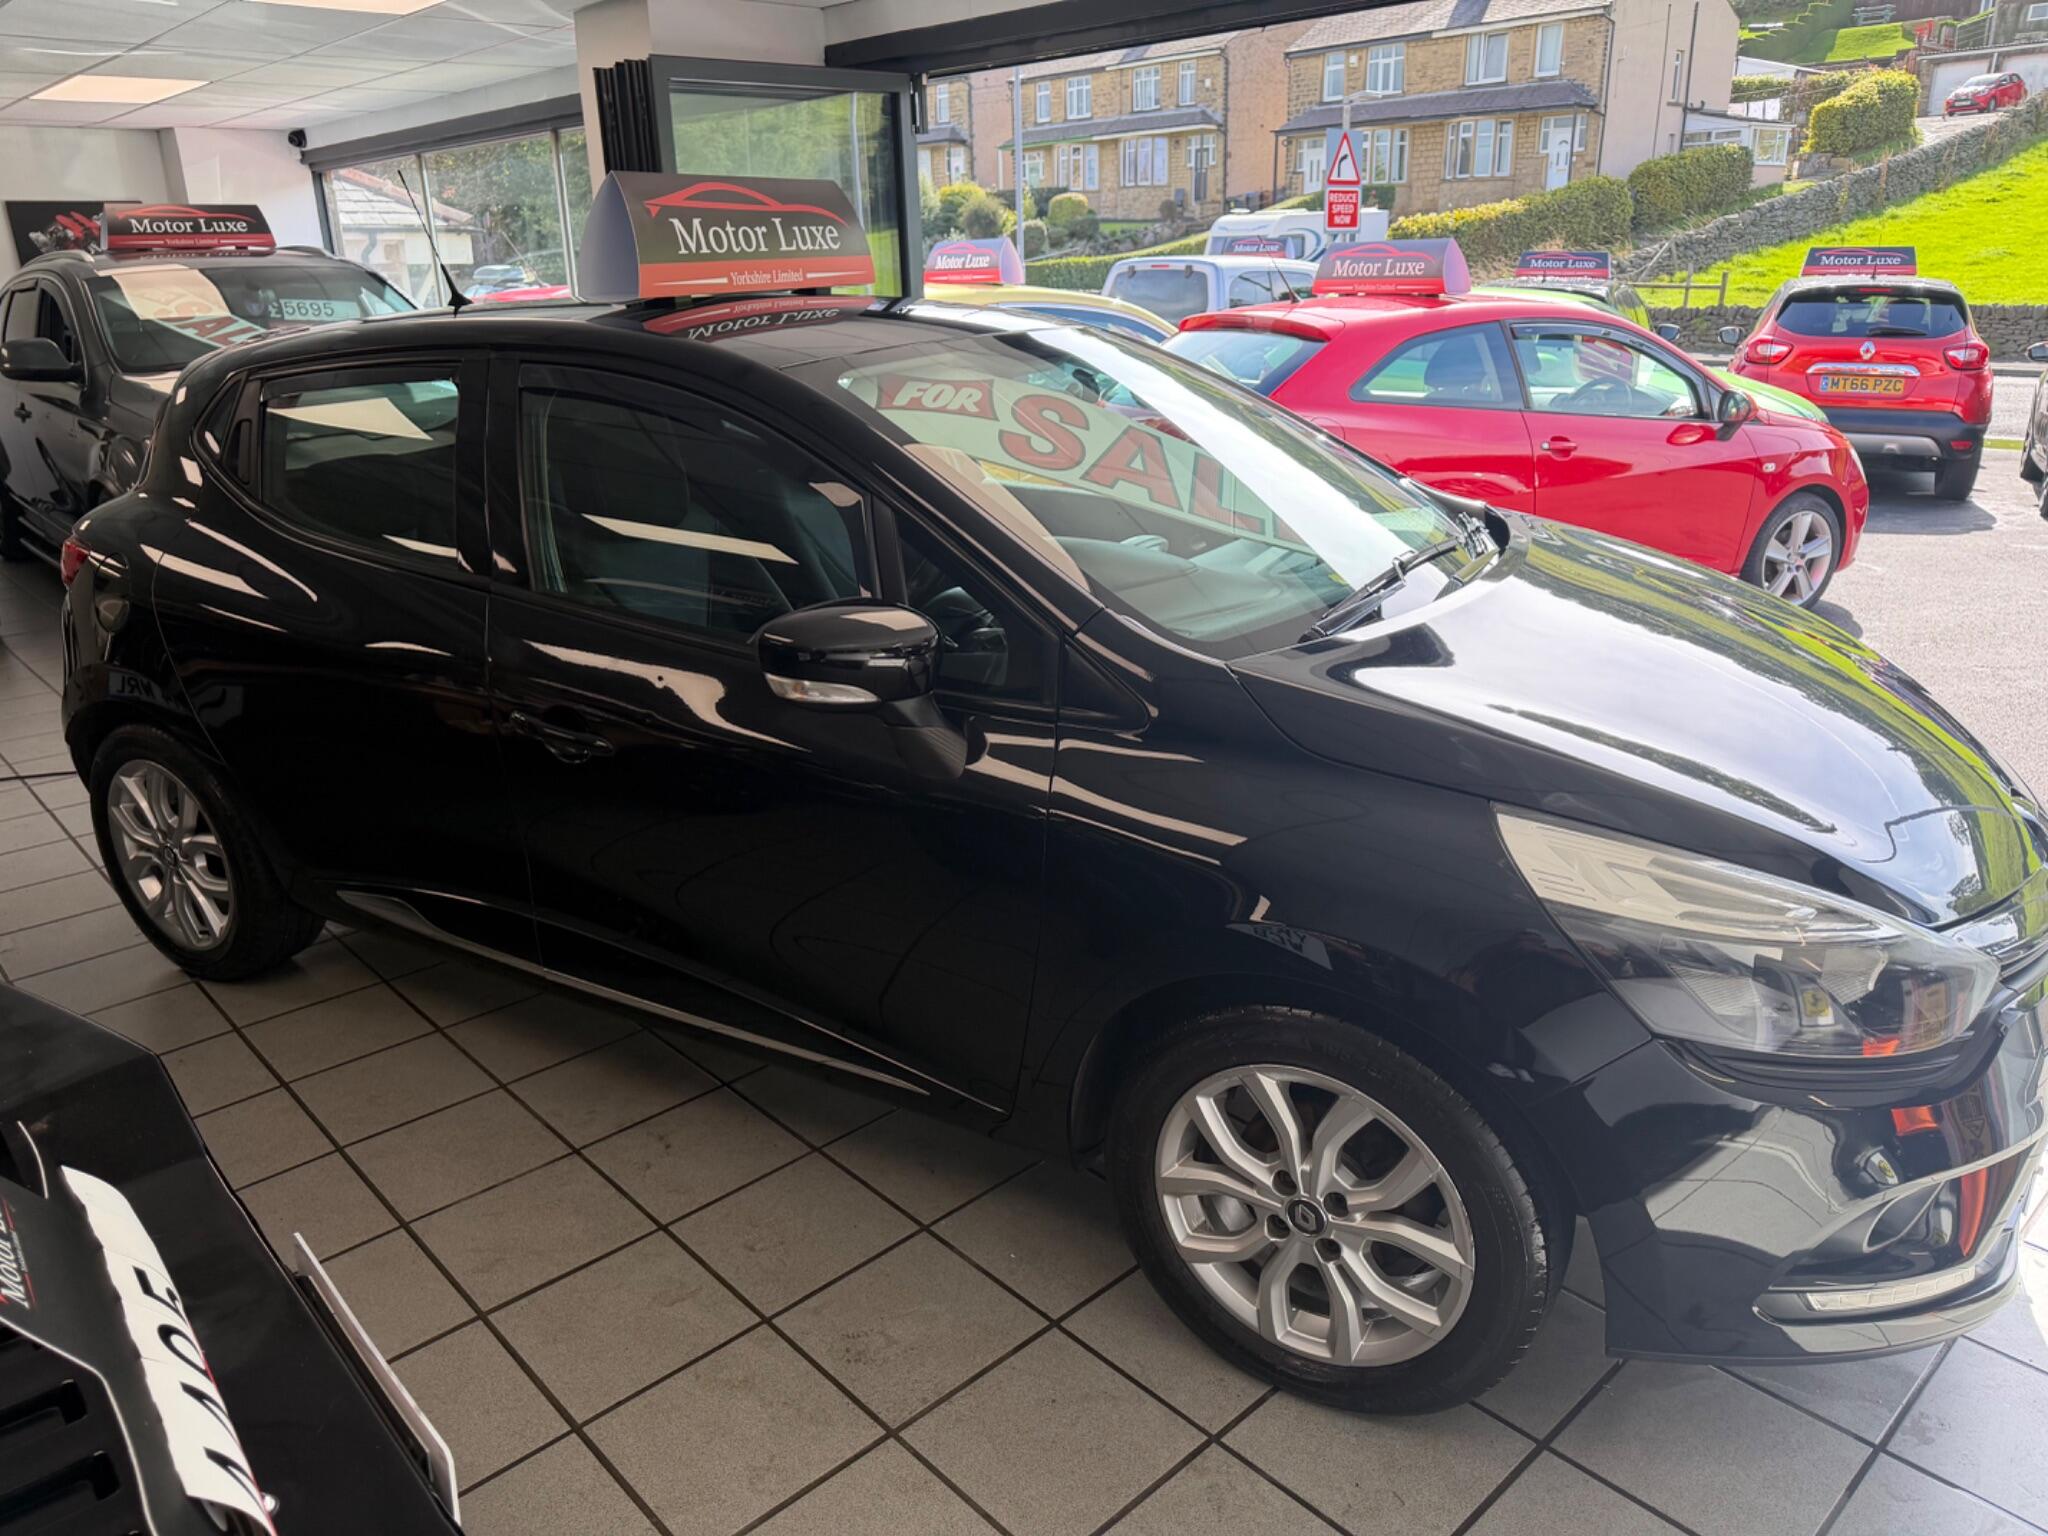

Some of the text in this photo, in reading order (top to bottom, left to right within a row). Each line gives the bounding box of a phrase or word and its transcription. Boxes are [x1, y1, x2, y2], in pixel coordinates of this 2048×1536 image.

[1329, 192, 1356, 203] REDUCE
[1331, 203, 1355, 214] SPEED
[128, 218, 248, 233] Motor Luxe
[1334, 214, 1351, 224] NOW
[669, 217, 841, 255] Motor Luxe
[935, 253, 990, 269] Motor Luxe
[1530, 258, 1597, 269] Motor Luxe
[1820, 255, 1902, 265] Motor Luxe
[1332, 259, 1425, 277] Motor Luxe
[730, 268, 803, 286] Yorkshire Limited
[1830, 378, 1903, 392] MT66 PZC
[893, 380, 983, 412] FOR
